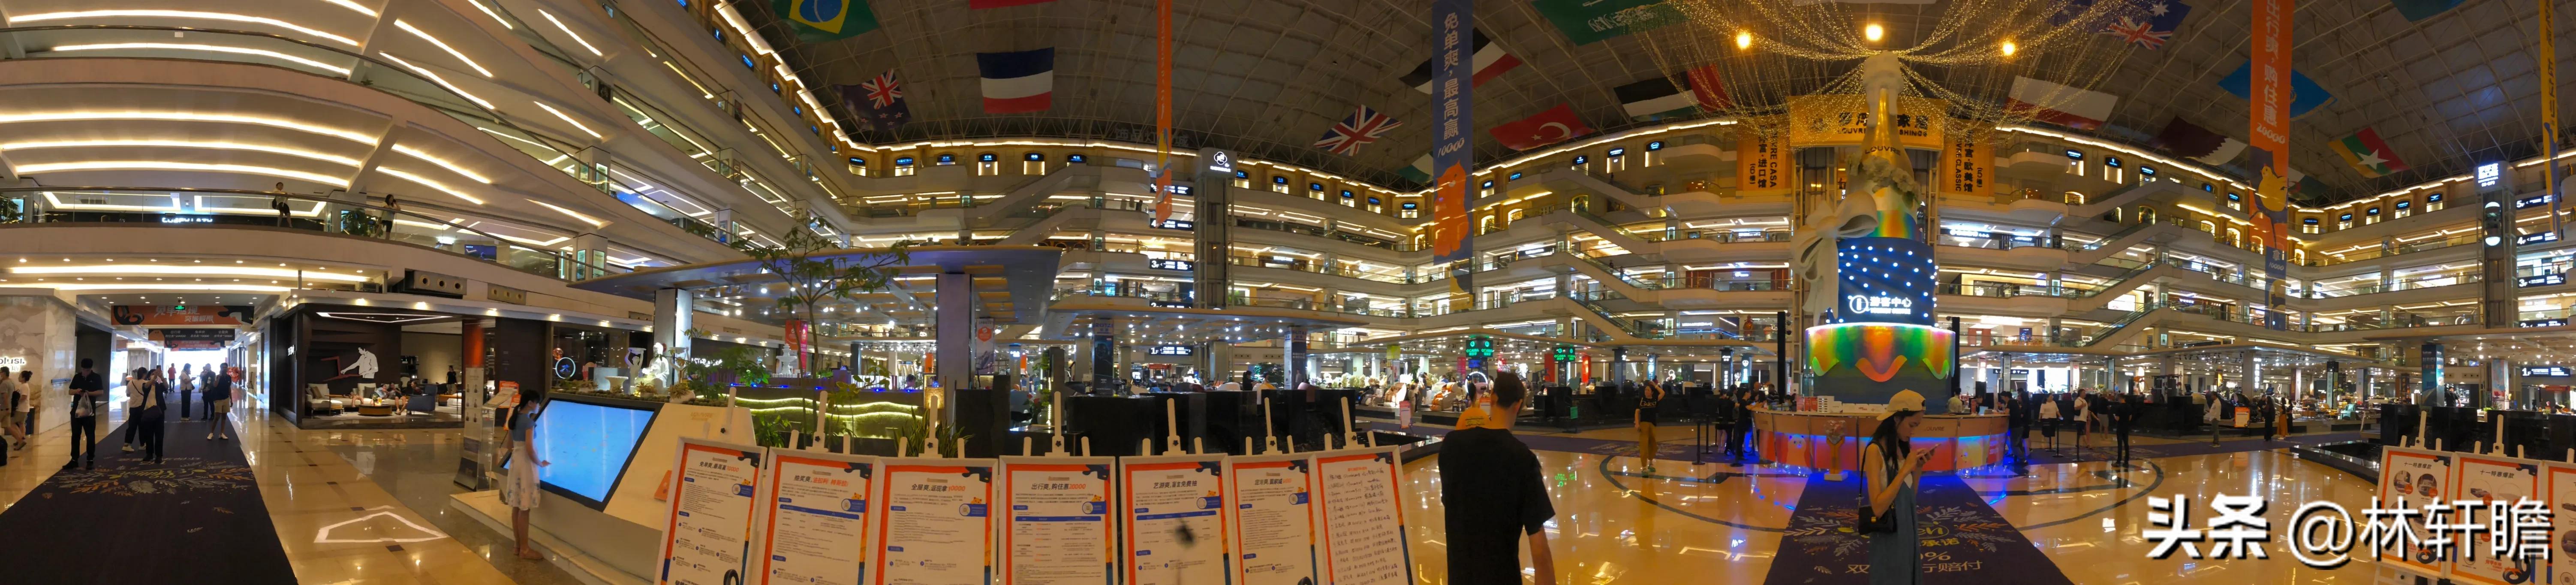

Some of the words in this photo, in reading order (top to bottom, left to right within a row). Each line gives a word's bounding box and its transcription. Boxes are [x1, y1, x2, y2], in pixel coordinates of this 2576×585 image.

[2257, 122, 2286, 144] 20000
[1438, 137, 1465, 158] 10000
[1865, 146, 1901, 155] LOUVRE
[2519, 279, 2528, 288] 3F
[2522, 368, 2531, 376] 1F
[2480, 470, 2515, 479] 十一特惠爆款
[1920, 538, 1960, 547] 承诺
